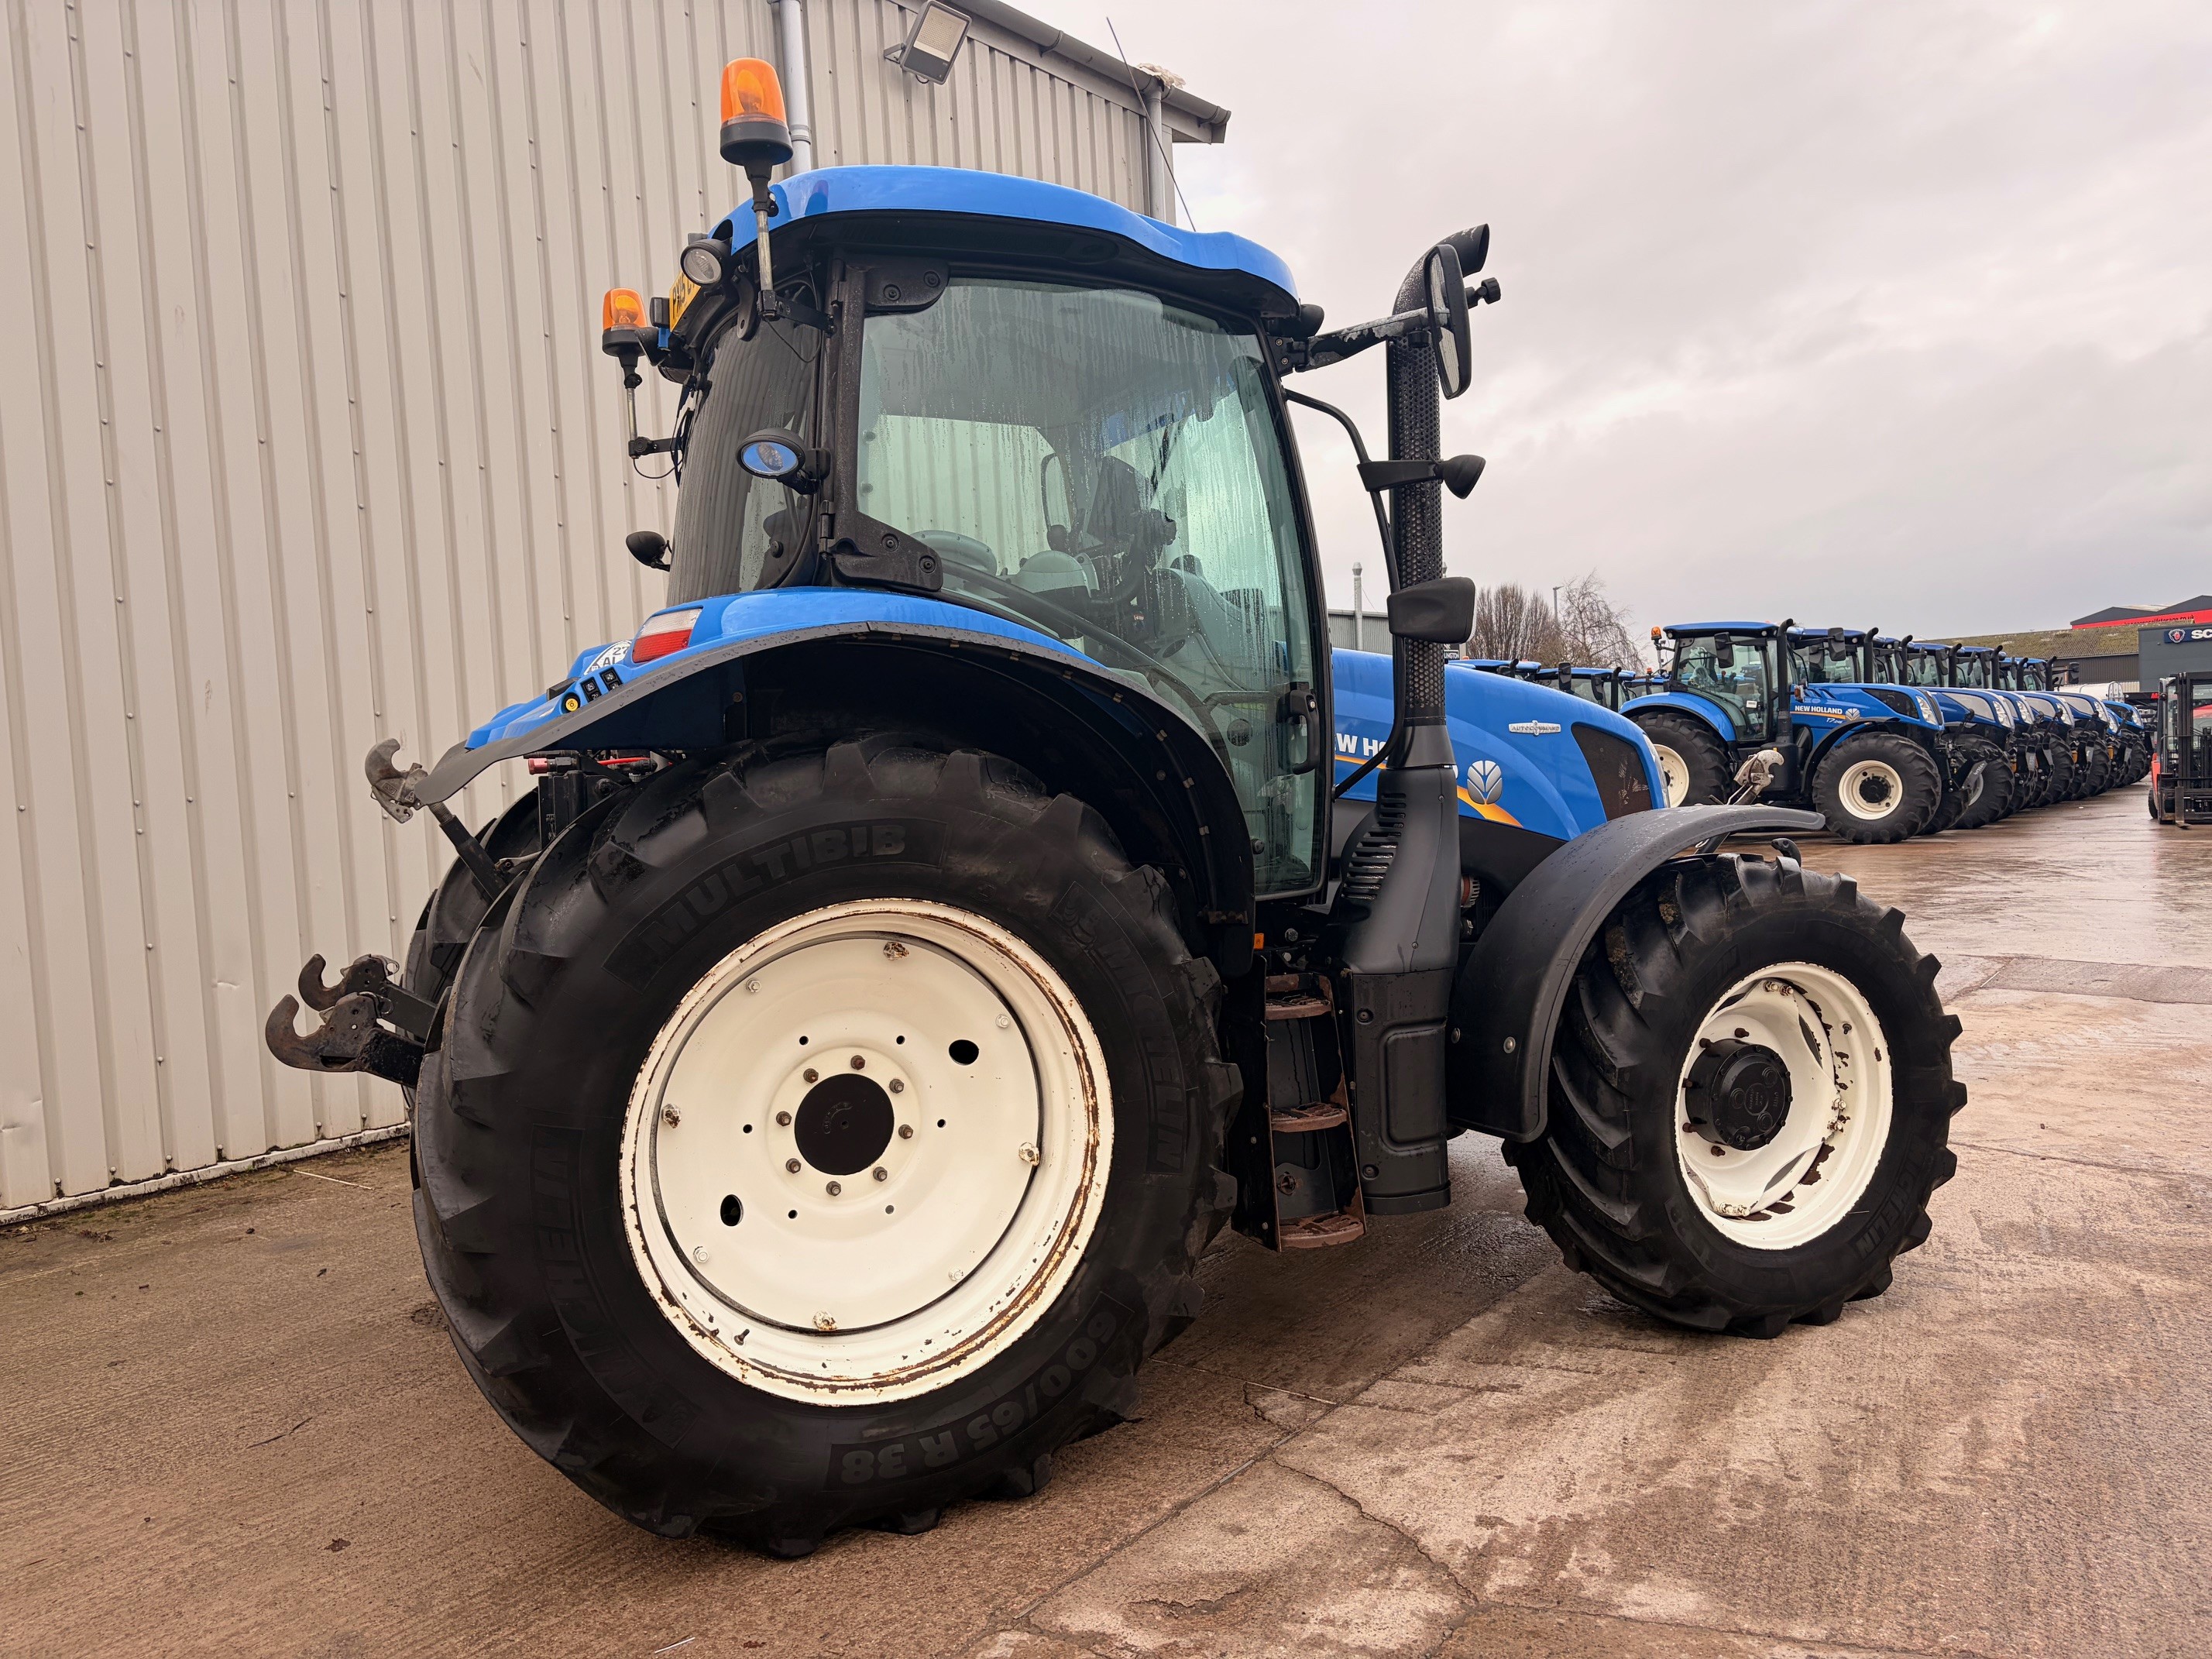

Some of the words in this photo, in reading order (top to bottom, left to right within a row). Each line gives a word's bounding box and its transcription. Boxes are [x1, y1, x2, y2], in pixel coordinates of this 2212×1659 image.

[640, 825, 905, 954] MULTIBIB
[1097, 938, 1183, 1170] MICHELIN
[967, 1311, 1116, 1450] 600/65
[840, 1443, 908, 1484] 38
[918, 1430, 960, 1468] R
